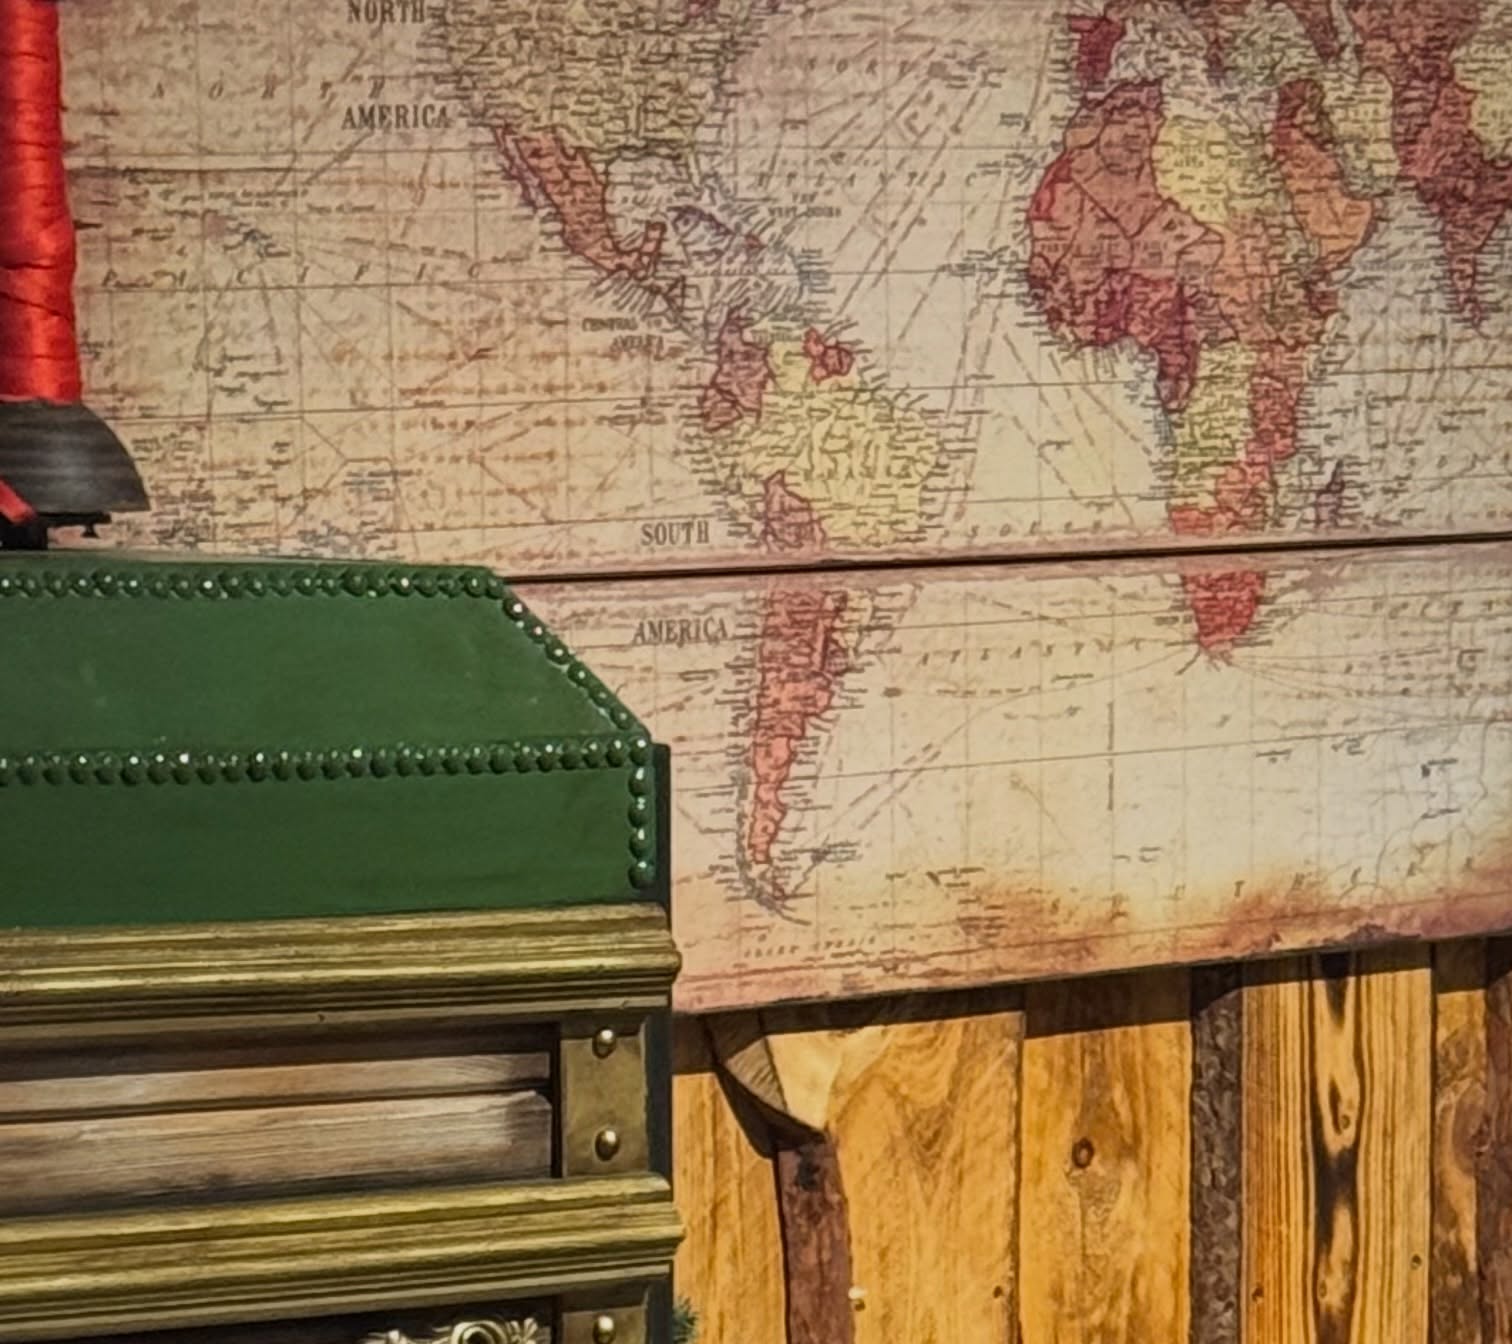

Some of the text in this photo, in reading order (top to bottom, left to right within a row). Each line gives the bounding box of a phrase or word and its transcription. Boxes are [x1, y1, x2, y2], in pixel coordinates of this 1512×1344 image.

[346, 0, 425, 24] NORTH
[341, 103, 450, 131] AMERICA
[640, 519, 709, 545] SOUTH
[632, 616, 728, 647] AMERICA
